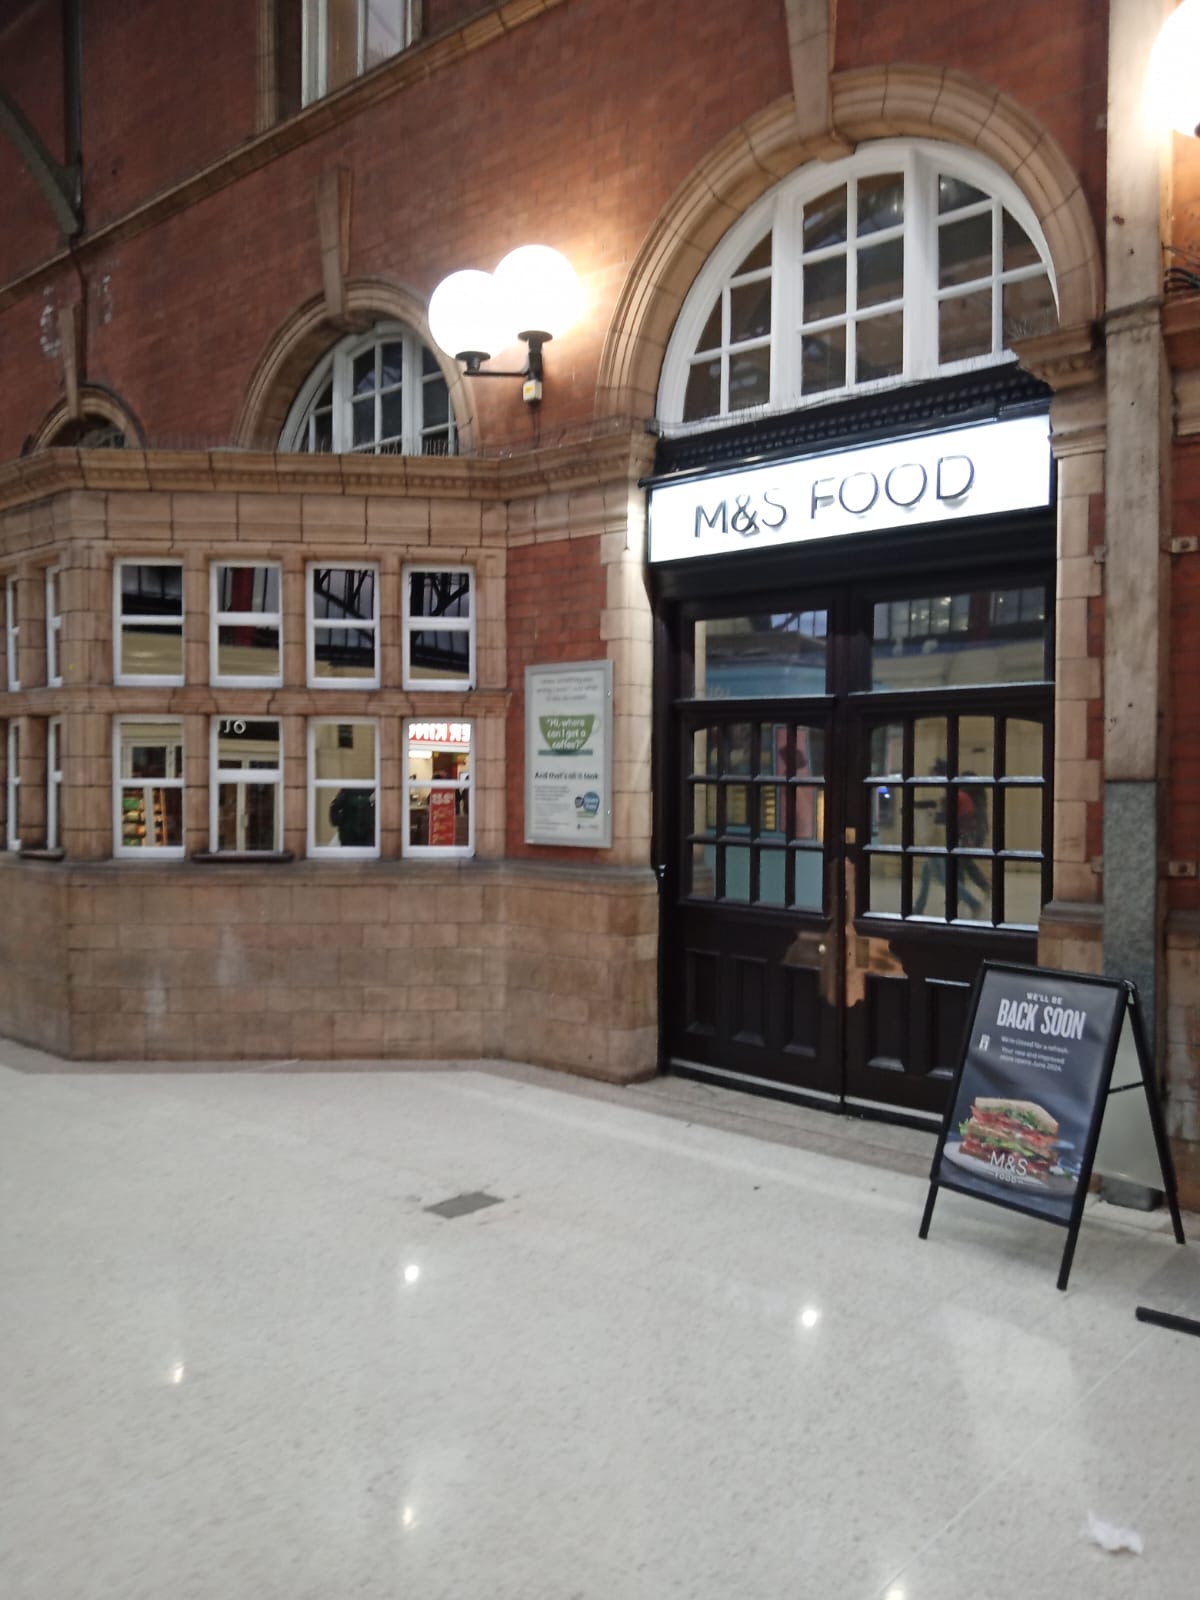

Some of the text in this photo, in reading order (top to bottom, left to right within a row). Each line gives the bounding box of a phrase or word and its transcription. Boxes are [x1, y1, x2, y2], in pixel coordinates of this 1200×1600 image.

[694, 455, 976, 538] M&S FOOD
[1026, 992, 1063, 1005] WE'LL BE
[996, 998, 1087, 1040] BACK SOON
[990, 1150, 1029, 1176] M&S
